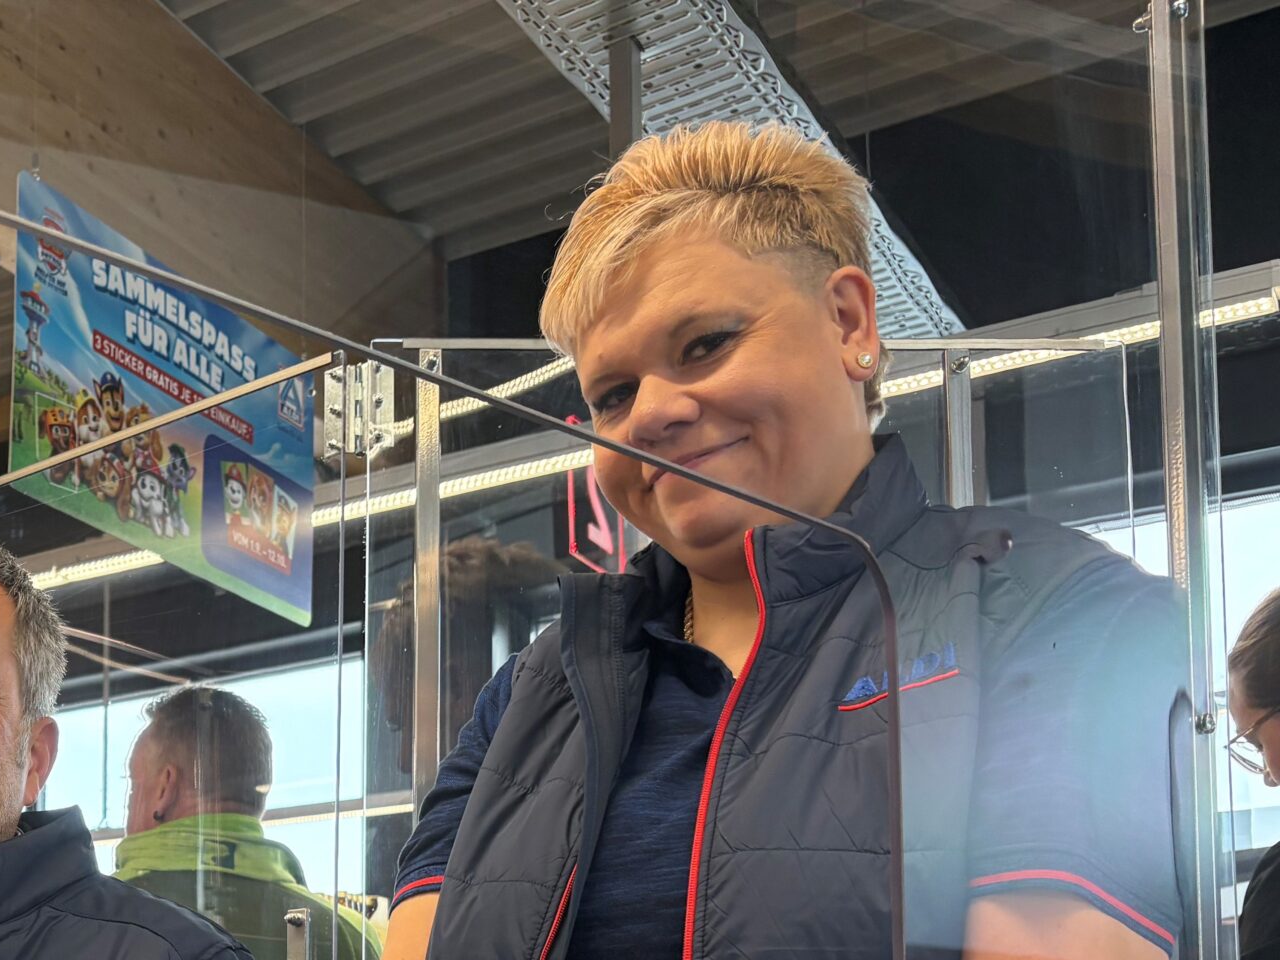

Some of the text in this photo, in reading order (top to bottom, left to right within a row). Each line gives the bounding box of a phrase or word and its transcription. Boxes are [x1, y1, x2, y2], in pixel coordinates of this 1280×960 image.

[92, 258, 256, 383] SAMMELSPASS
[125, 310, 169, 358] FÜR
[93, 334, 102, 350] 3
[102, 340, 144, 376] STICKER
[145, 367, 179, 396] GRATIS
[180, 389, 192, 404] JE
